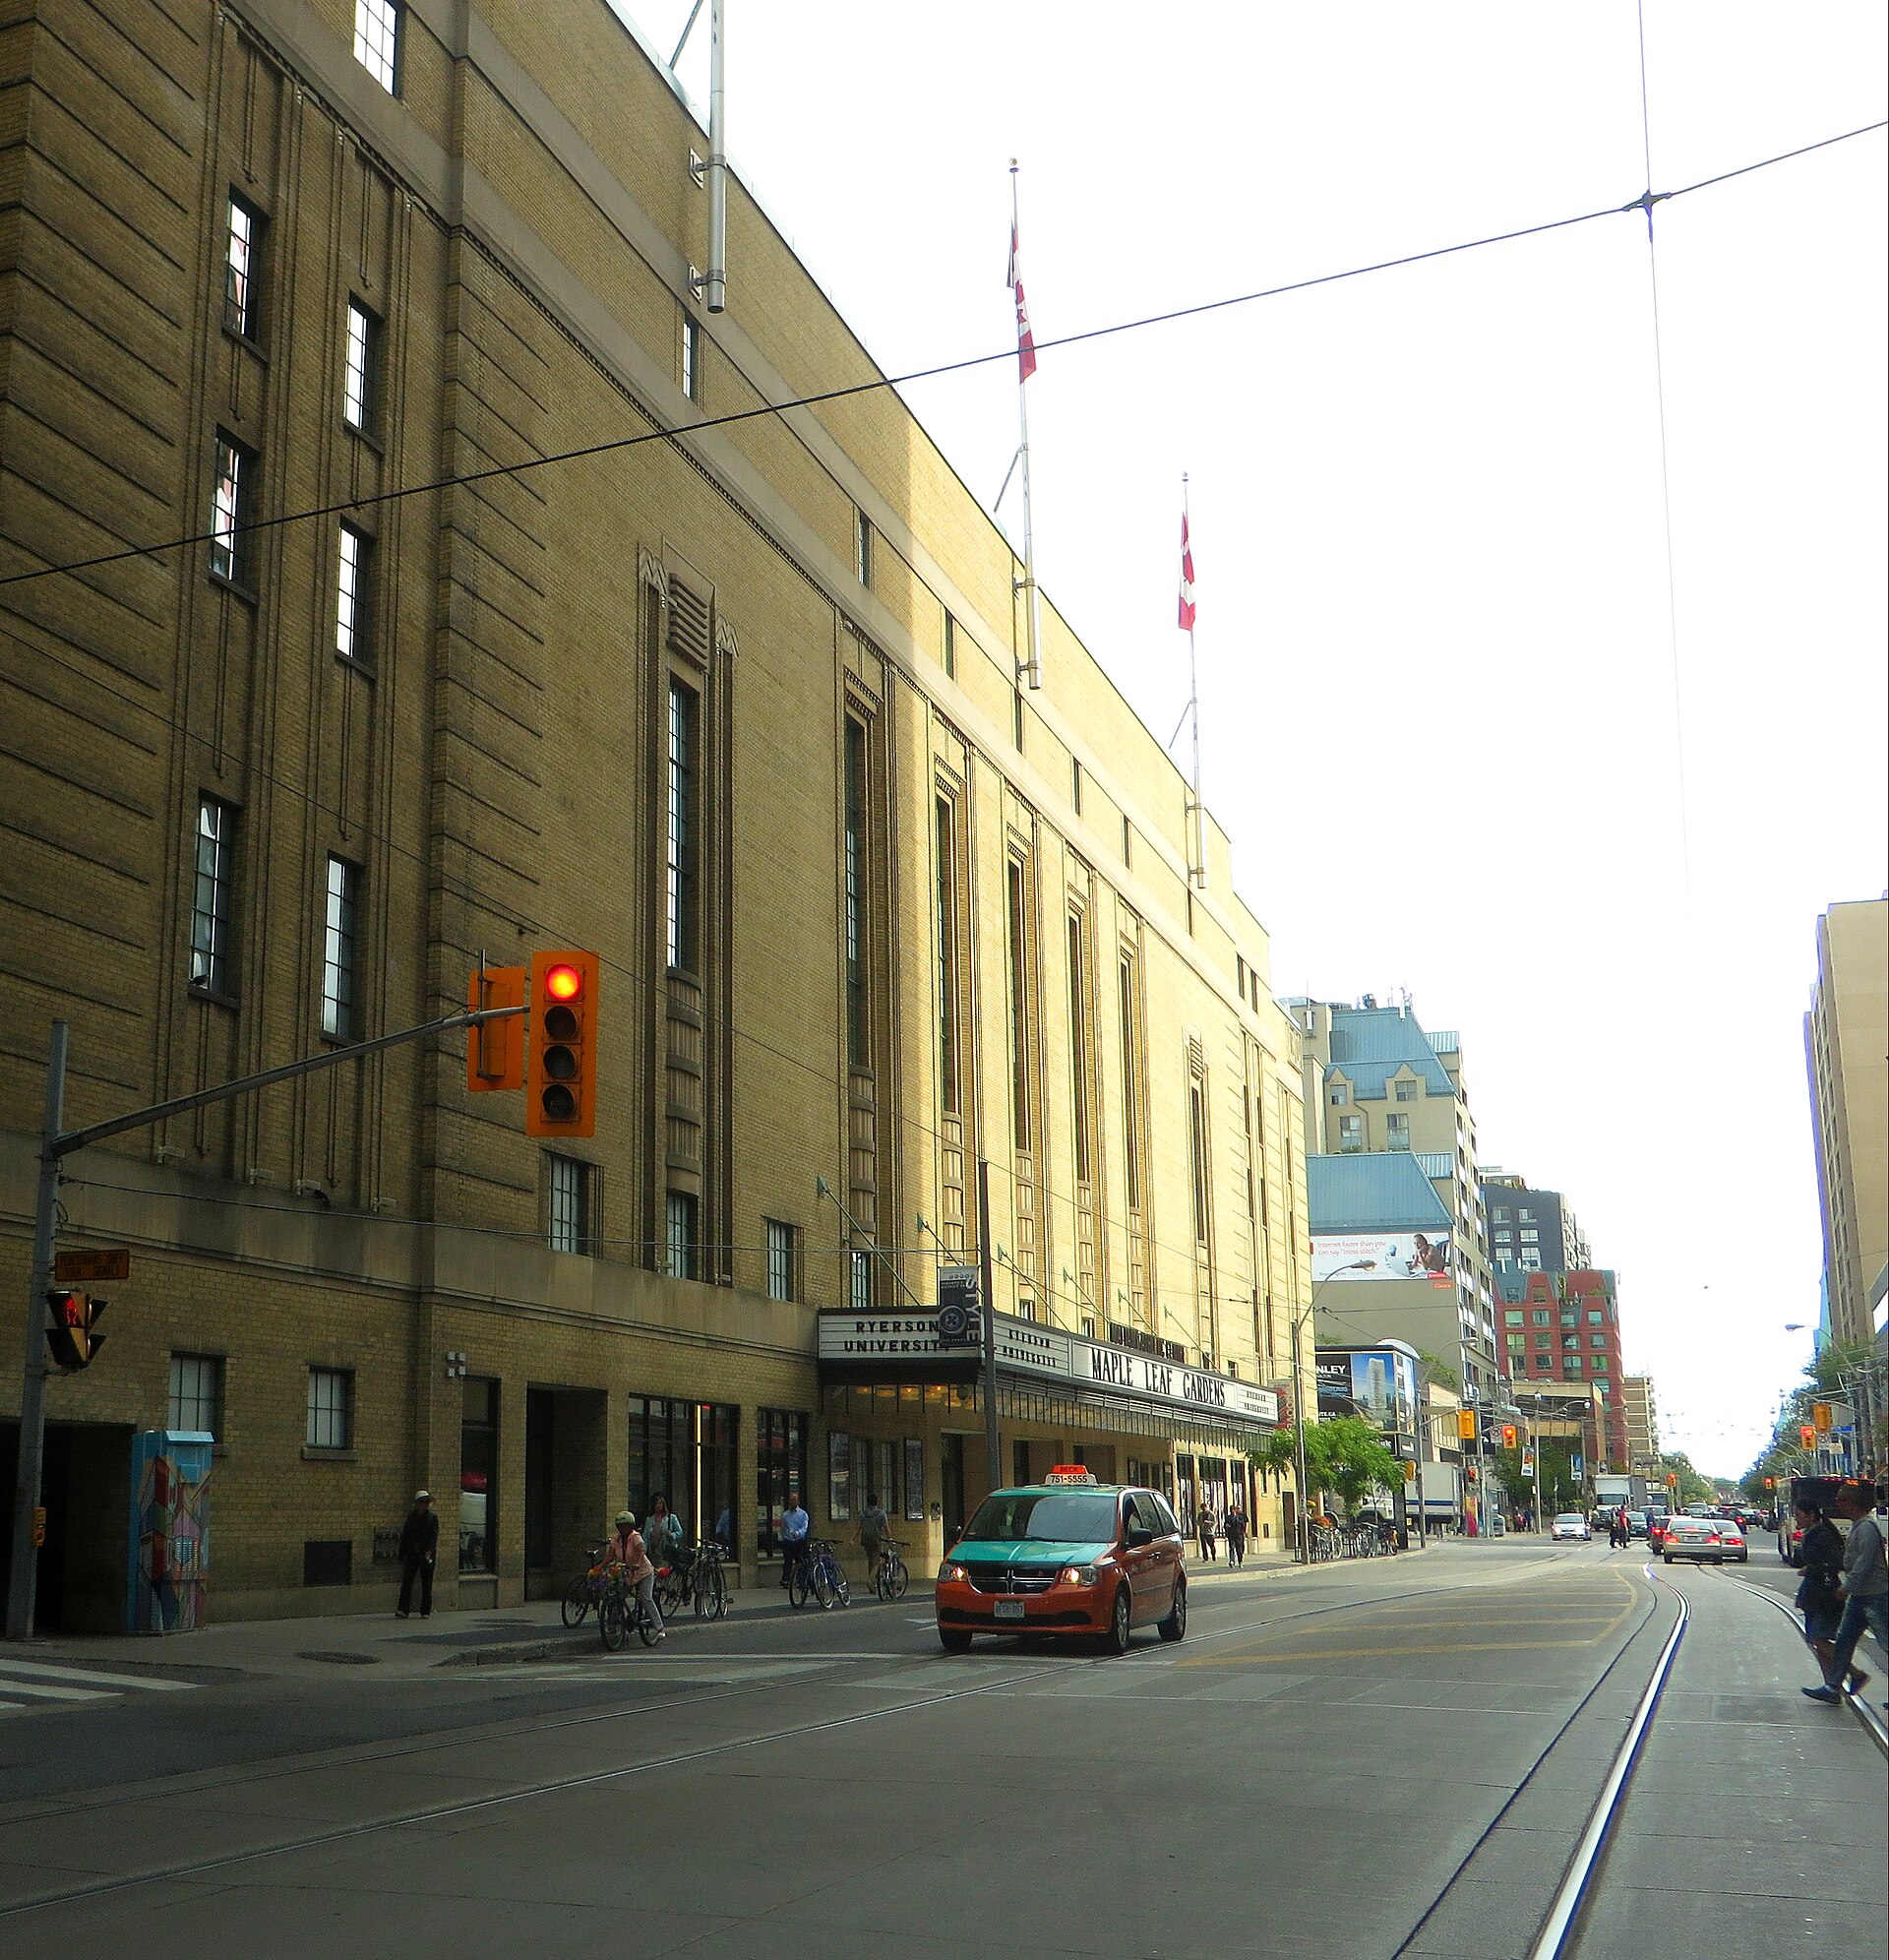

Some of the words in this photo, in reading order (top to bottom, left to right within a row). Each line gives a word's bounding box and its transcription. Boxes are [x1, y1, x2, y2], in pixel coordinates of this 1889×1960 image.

[1374, 1241, 1386, 1250] you
[856, 1320, 940, 1333] RYERSON
[844, 1339, 948, 1352] UNIVERSIT
[1092, 1347, 1133, 1386] MAPLE
[1145, 1361, 1173, 1395] LEAF
[1183, 1372, 1226, 1407] GARDENS
[1051, 1475, 1087, 1484] 751-5555
